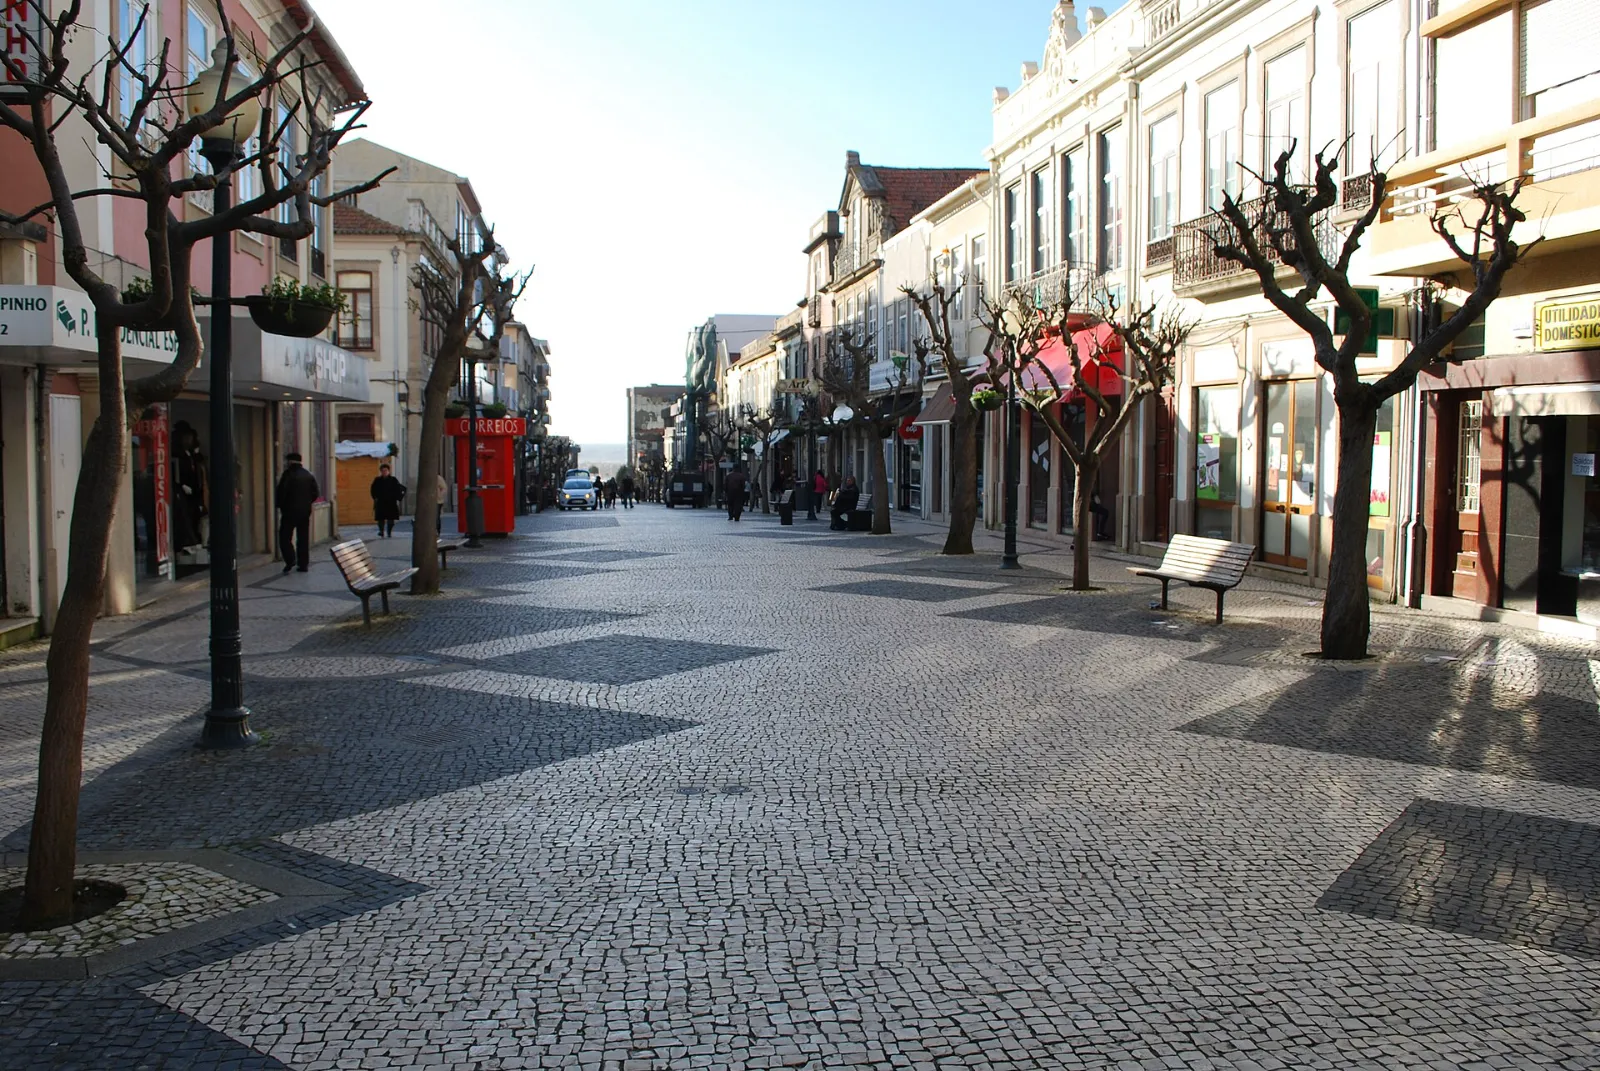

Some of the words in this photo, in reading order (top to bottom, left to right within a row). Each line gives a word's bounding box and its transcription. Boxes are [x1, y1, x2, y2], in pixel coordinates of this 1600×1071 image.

[1, 297, 47, 311] PINHO
[1545, 304, 1600, 323] UTILIDAD
[81, 308, 90, 337] P.
[314, 344, 346, 383] SHOP
